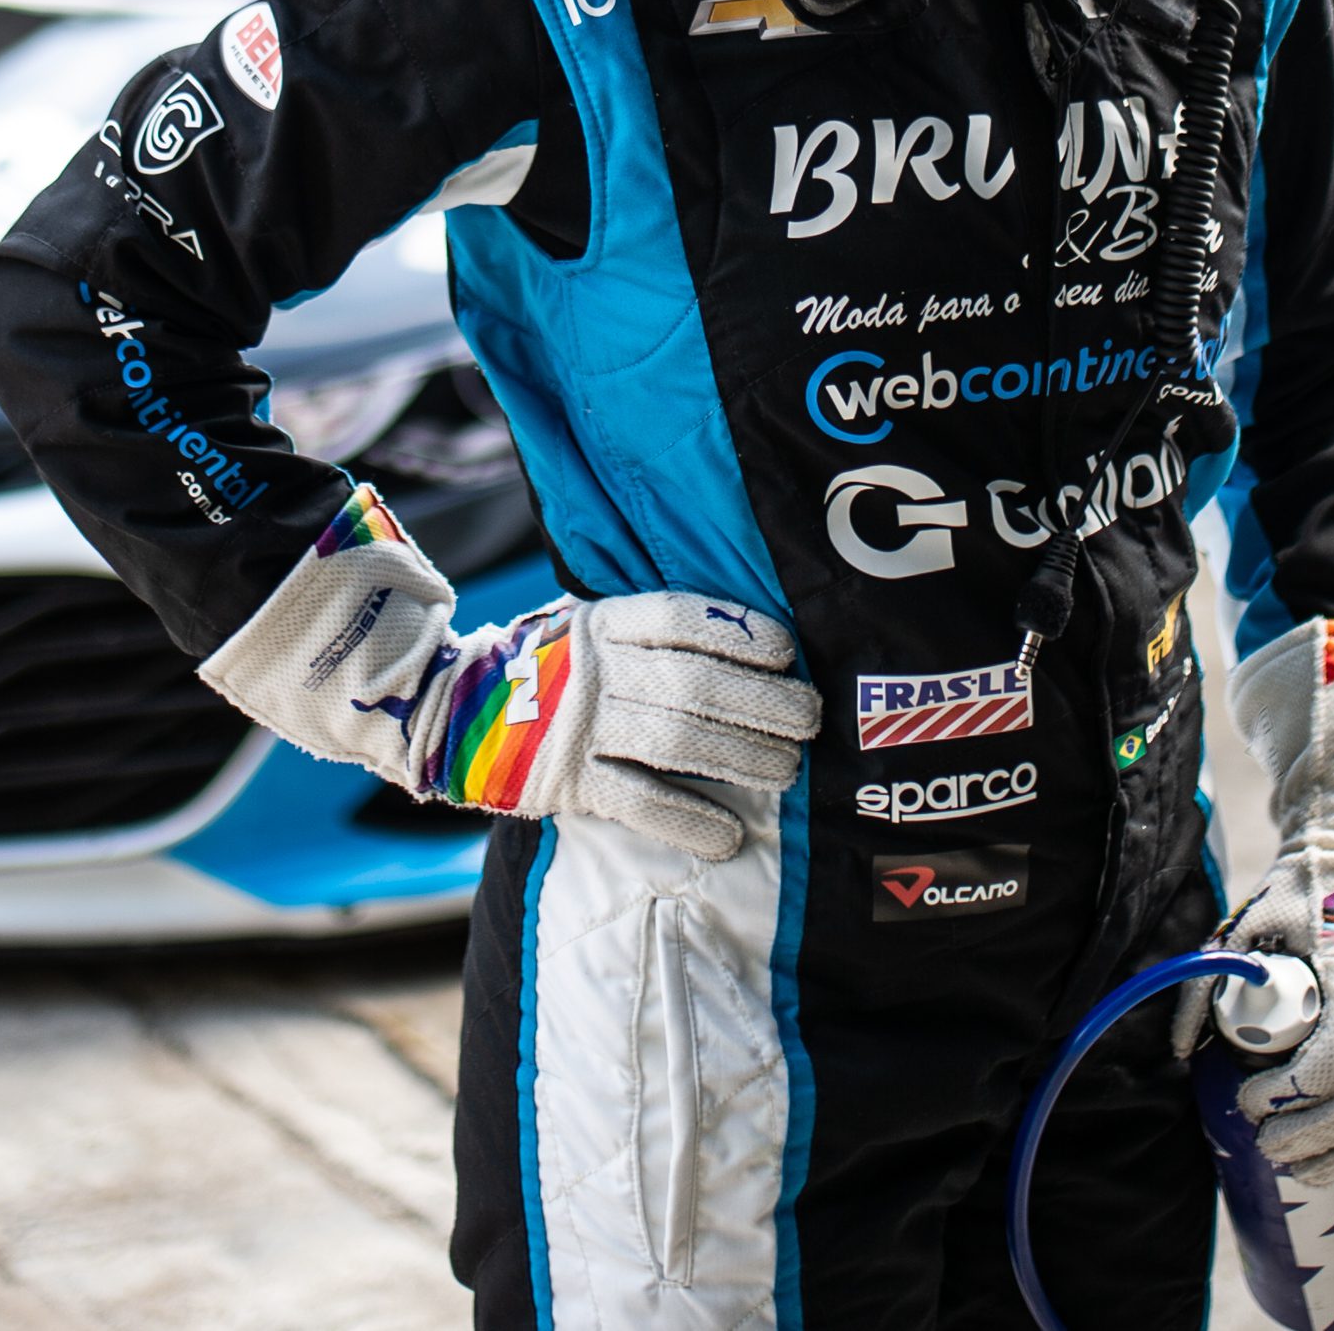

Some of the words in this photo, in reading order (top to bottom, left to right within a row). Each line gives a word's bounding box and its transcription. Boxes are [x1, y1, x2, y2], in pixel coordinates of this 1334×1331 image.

[230, 43, 271, 101] HELMETS
[796, 291, 907, 334] Moda
[917, 293, 995, 333] para
[1003, 292, 1022, 314] o
[1054, 283, 1103, 308] seu
[1114, 269, 1150, 303] dia
[176, 470, 233, 526] .com.br
[856, 762, 1038, 823] sparco
